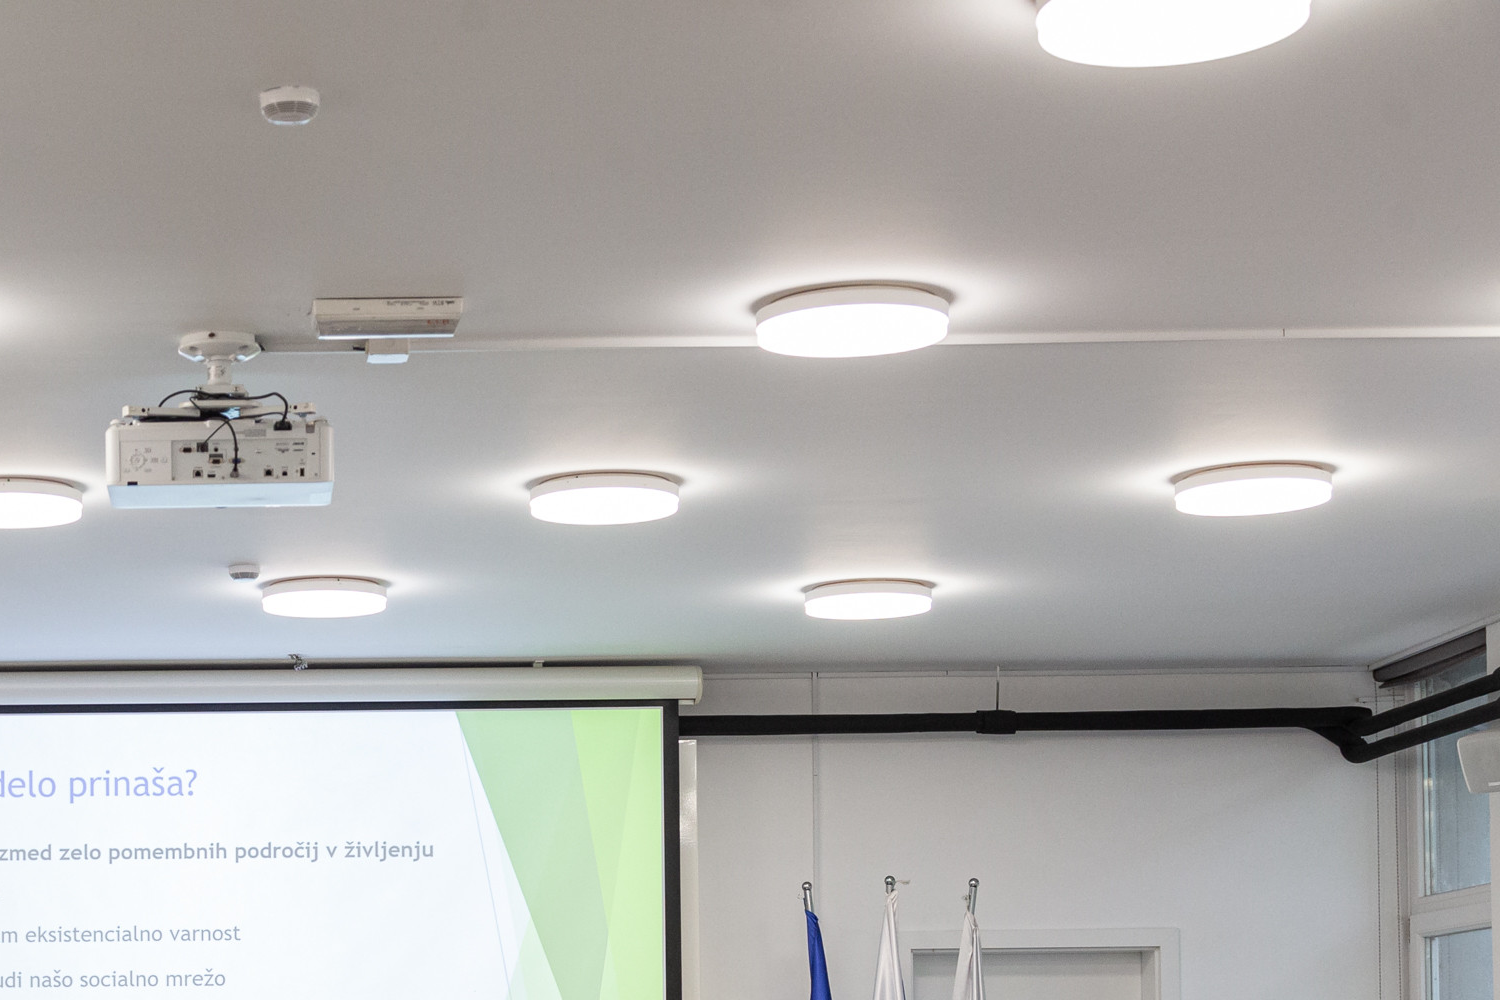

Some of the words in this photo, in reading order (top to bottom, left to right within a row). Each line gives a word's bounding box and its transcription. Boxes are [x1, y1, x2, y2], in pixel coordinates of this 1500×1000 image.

[69, 766, 198, 805] prinaša?
[58, 843, 102, 861] zelo
[108, 841, 228, 865] pomembnih
[235, 841, 319, 864] področij
[325, 845, 338, 859] v
[344, 840, 434, 863] življenju
[25, 924, 163, 943] eksistencialno
[169, 925, 241, 942] varnost
[29, 969, 74, 989] našo
[79, 969, 159, 988] socialno
[166, 967, 226, 987] mrežo
